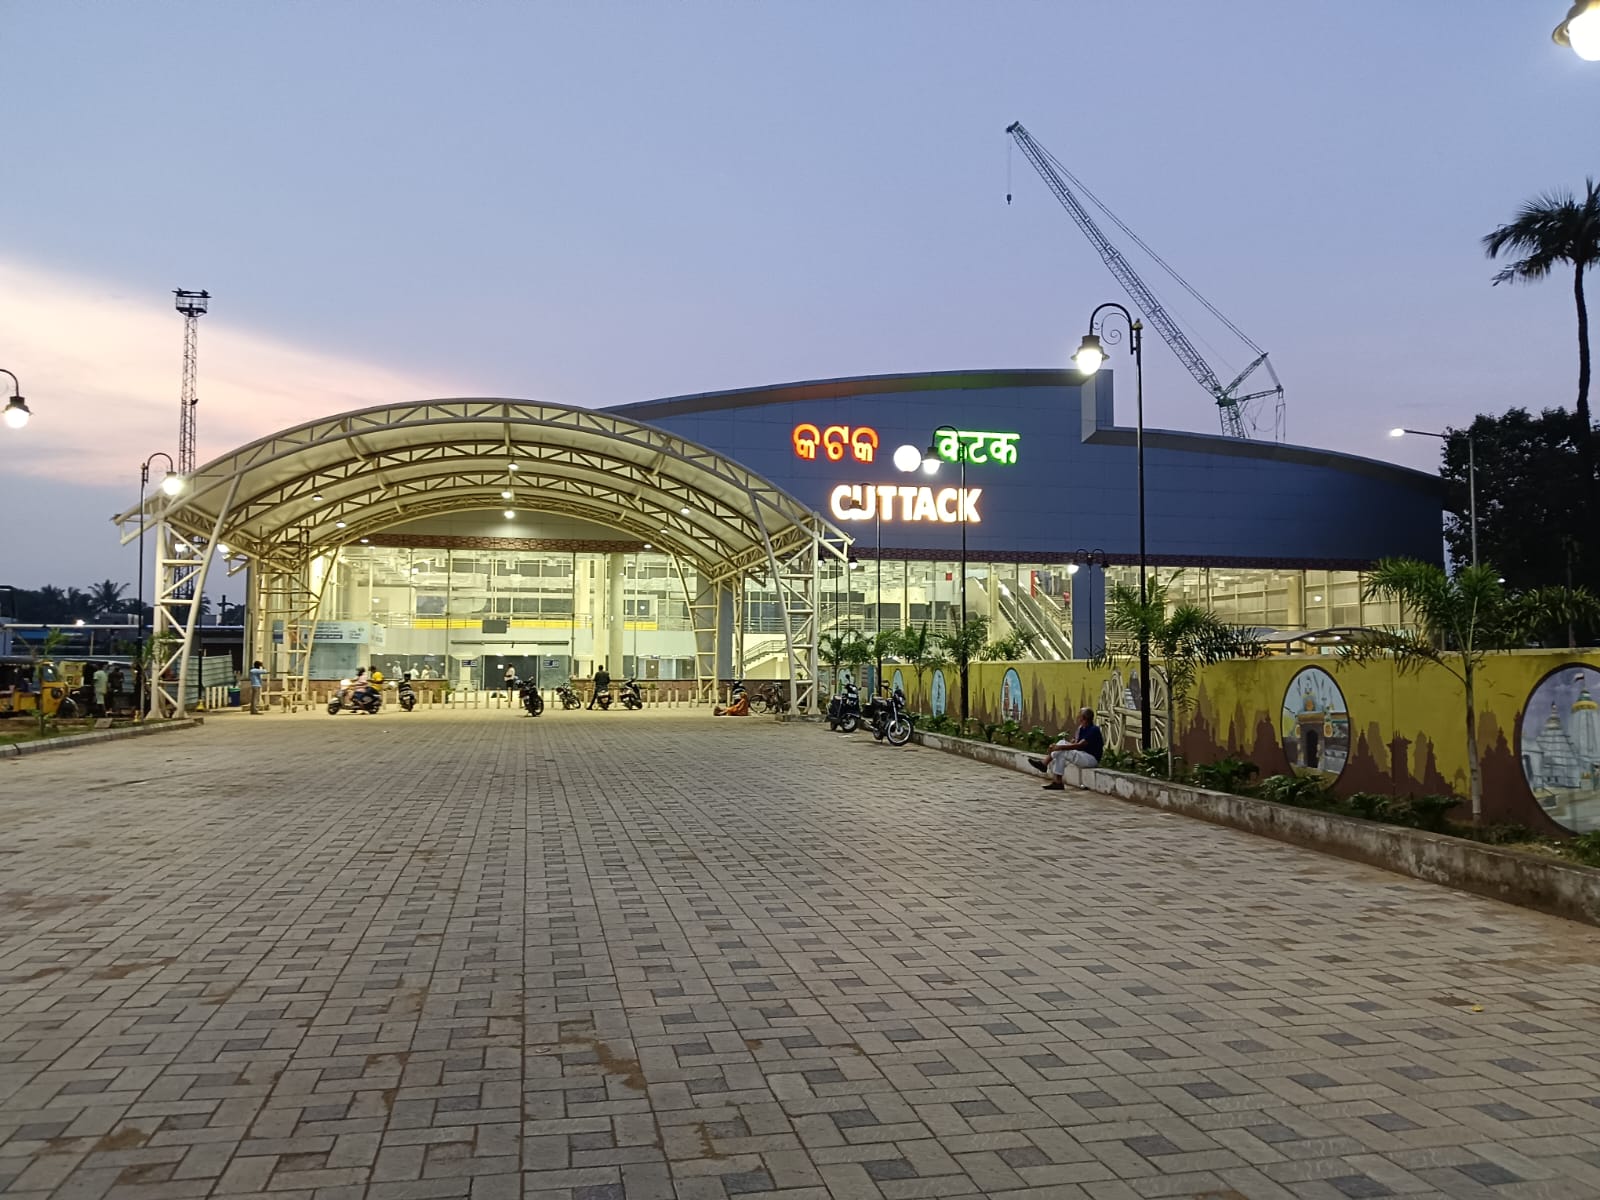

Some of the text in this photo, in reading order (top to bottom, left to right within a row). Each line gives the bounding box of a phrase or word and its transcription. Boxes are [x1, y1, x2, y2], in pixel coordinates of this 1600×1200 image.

[793, 424, 878, 463] କଟକ
[935, 430, 1021, 464] कटक
[831, 485, 982, 522] CUTTACK
